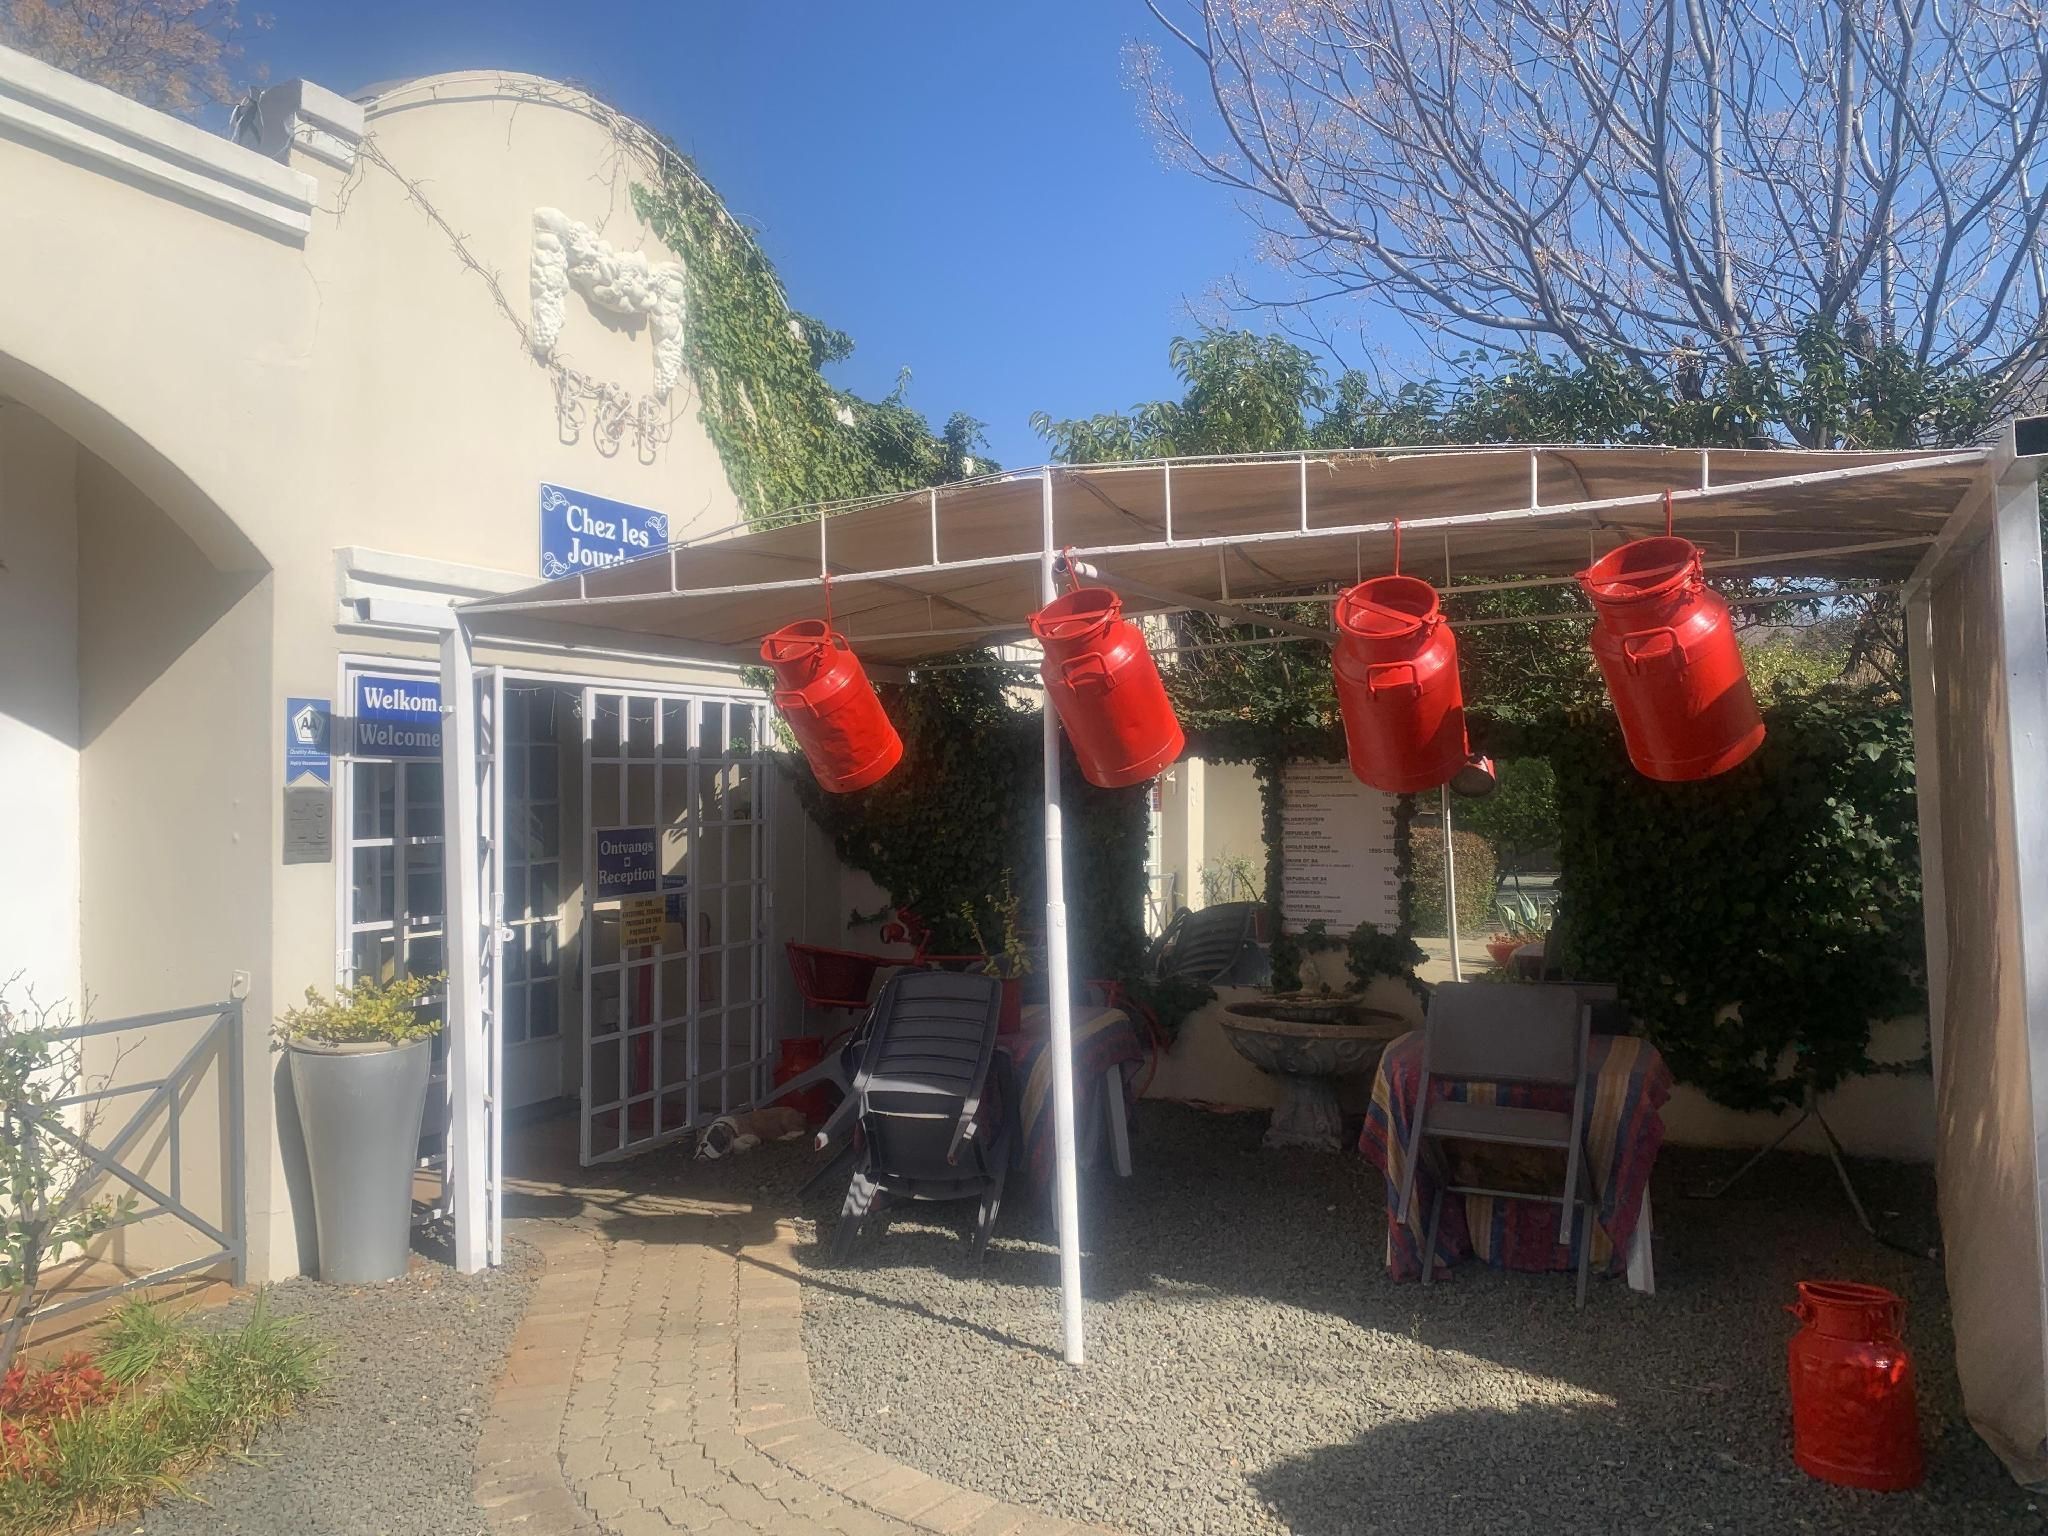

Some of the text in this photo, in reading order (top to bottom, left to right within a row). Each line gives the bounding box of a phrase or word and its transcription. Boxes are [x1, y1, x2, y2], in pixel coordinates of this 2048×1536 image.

[566, 504, 649, 548] Chez les
[567, 537, 634, 569] Jourd
[363, 686, 437, 712] Welkom
[301, 717, 317, 730] AA
[359, 723, 441, 747] Welcome
[600, 840, 654, 856] Ontvangs
[598, 867, 655, 885] Reception
